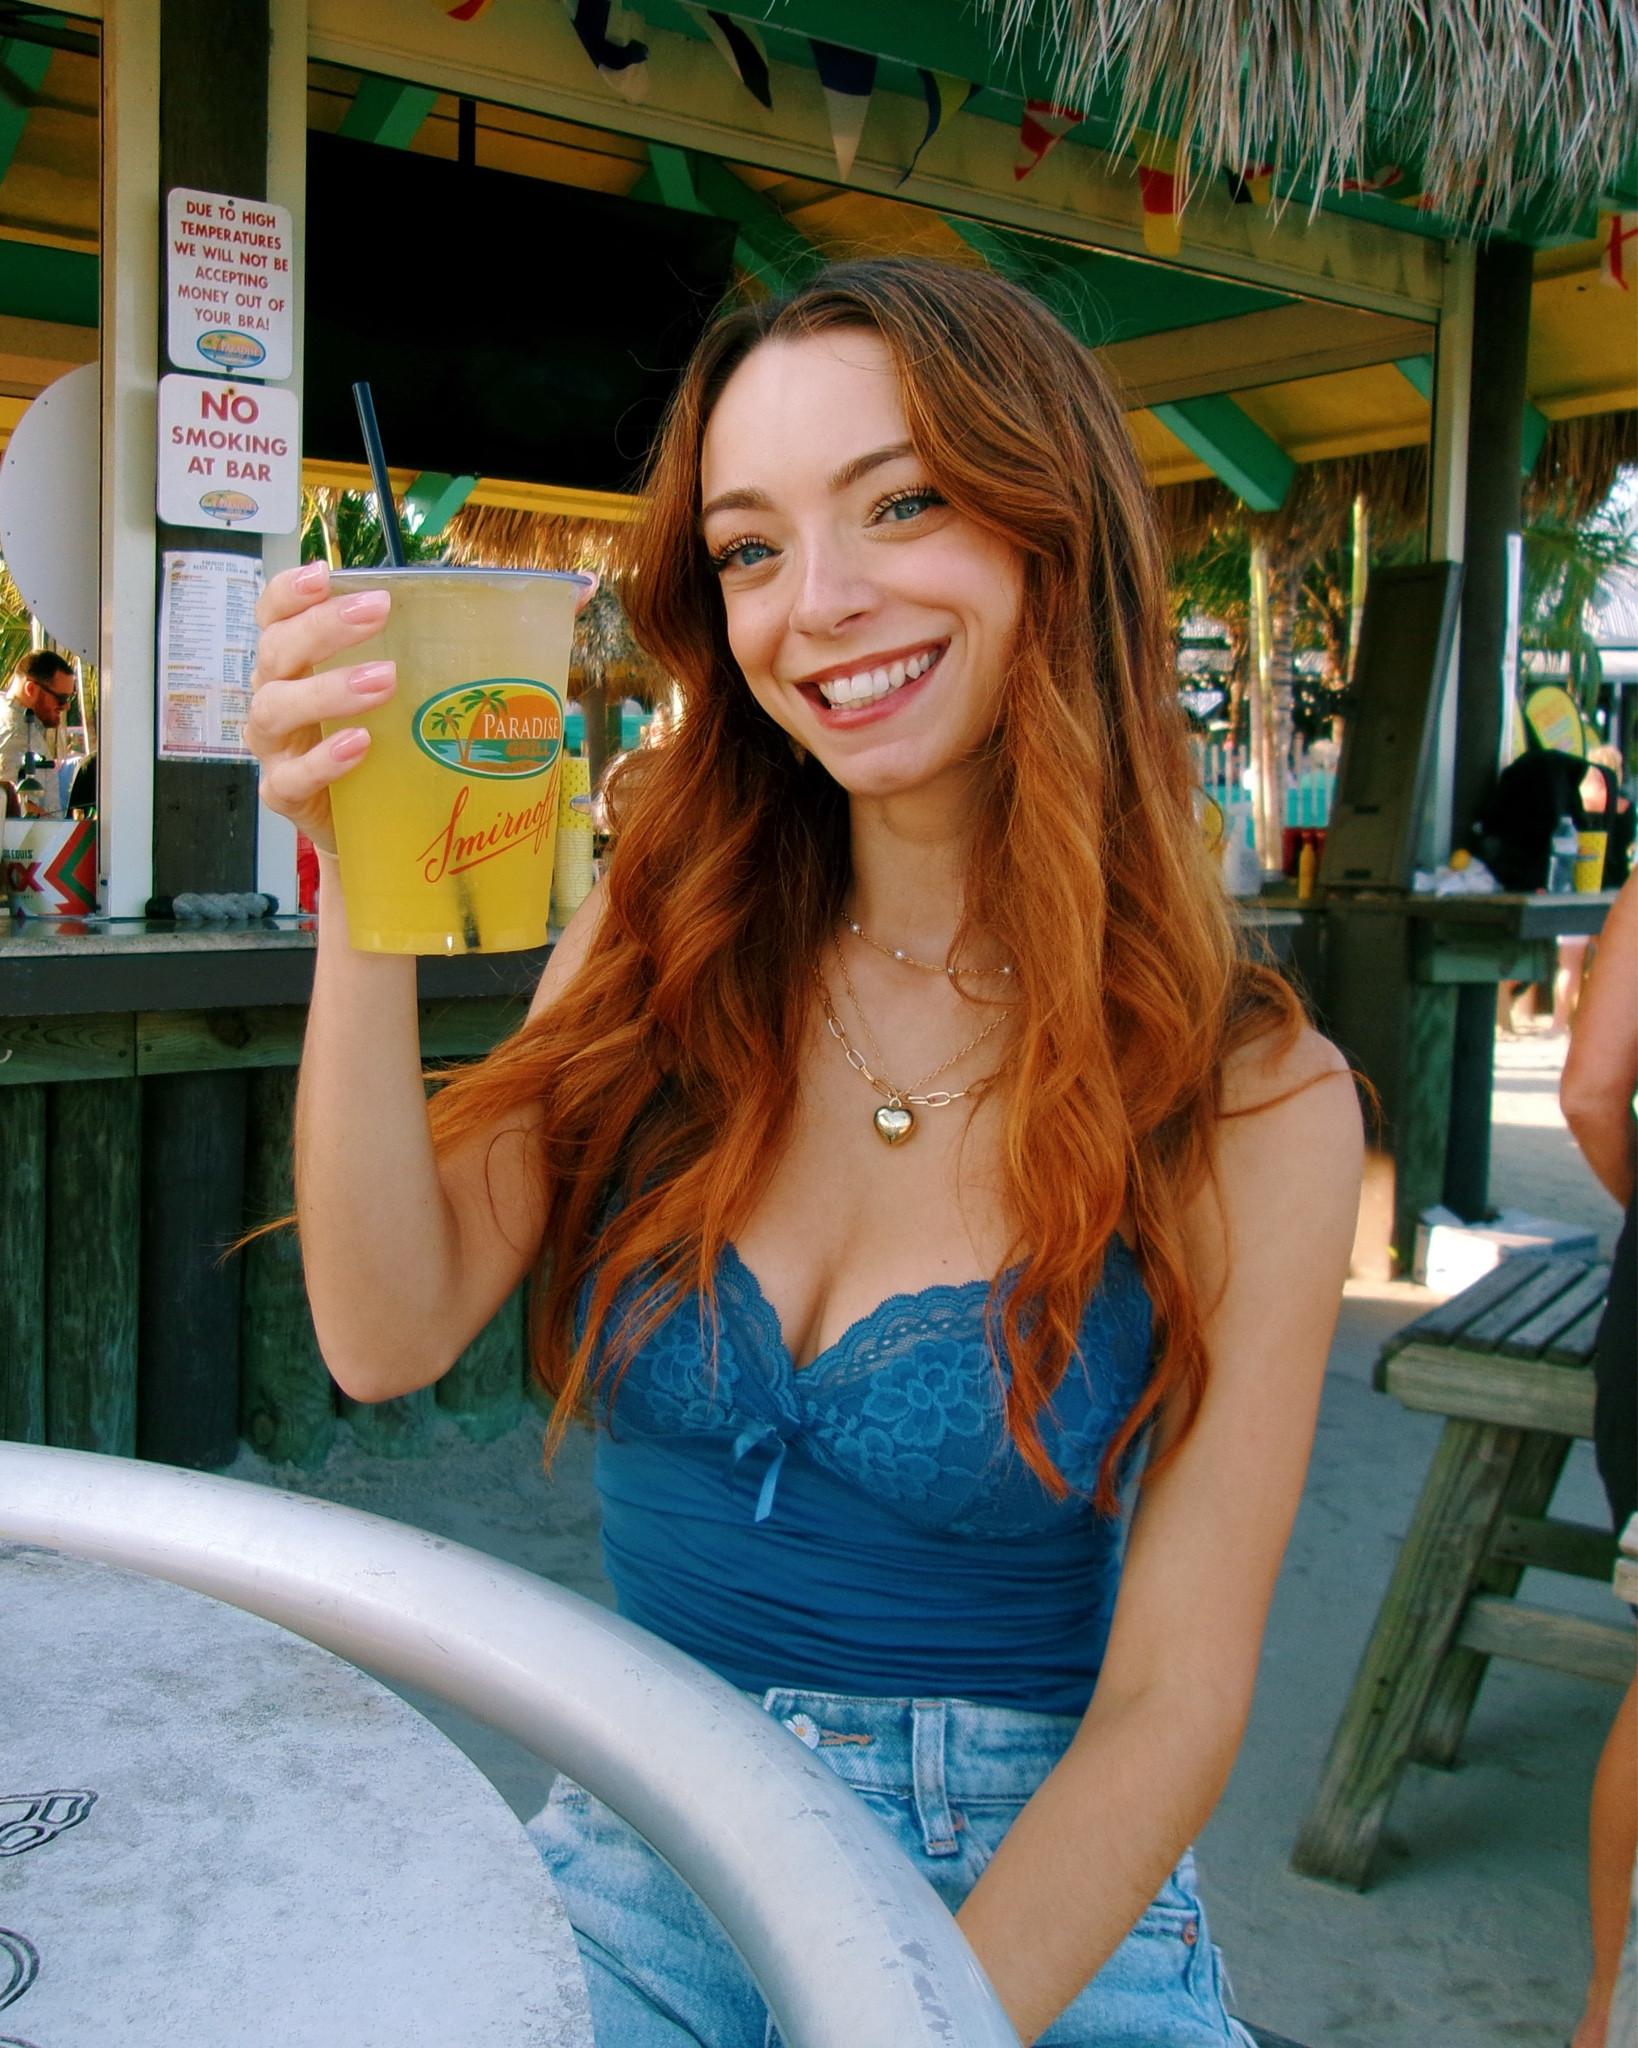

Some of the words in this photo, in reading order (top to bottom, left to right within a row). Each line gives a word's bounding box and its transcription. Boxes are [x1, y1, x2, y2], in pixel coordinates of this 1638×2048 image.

[186, 201, 212, 218] DUE
[218, 206, 235, 221] TO
[242, 211, 276, 228] HIGH
[181, 221, 282, 250] TEMPERATURES
[174, 241, 196, 257] WE
[202, 245, 234, 263] WILL
[240, 252, 268, 269] NOT
[274, 257, 288, 272] BE
[195, 266, 268, 289] ACCEPTING
[178, 284, 229, 304] MONEY
[235, 293, 262, 309] OUT
[268, 298, 285, 312] OF
[195, 308, 231, 325] YOUR
[238, 316, 270, 331] BRA!
[201, 390, 259, 424] NO
[172, 426, 288, 457] SMOKING
[187, 456, 215, 476] AT
[226, 459, 272, 482] BAR
[484, 713, 559, 739] PARADISE
[416, 763, 560, 883] Smirnoff
